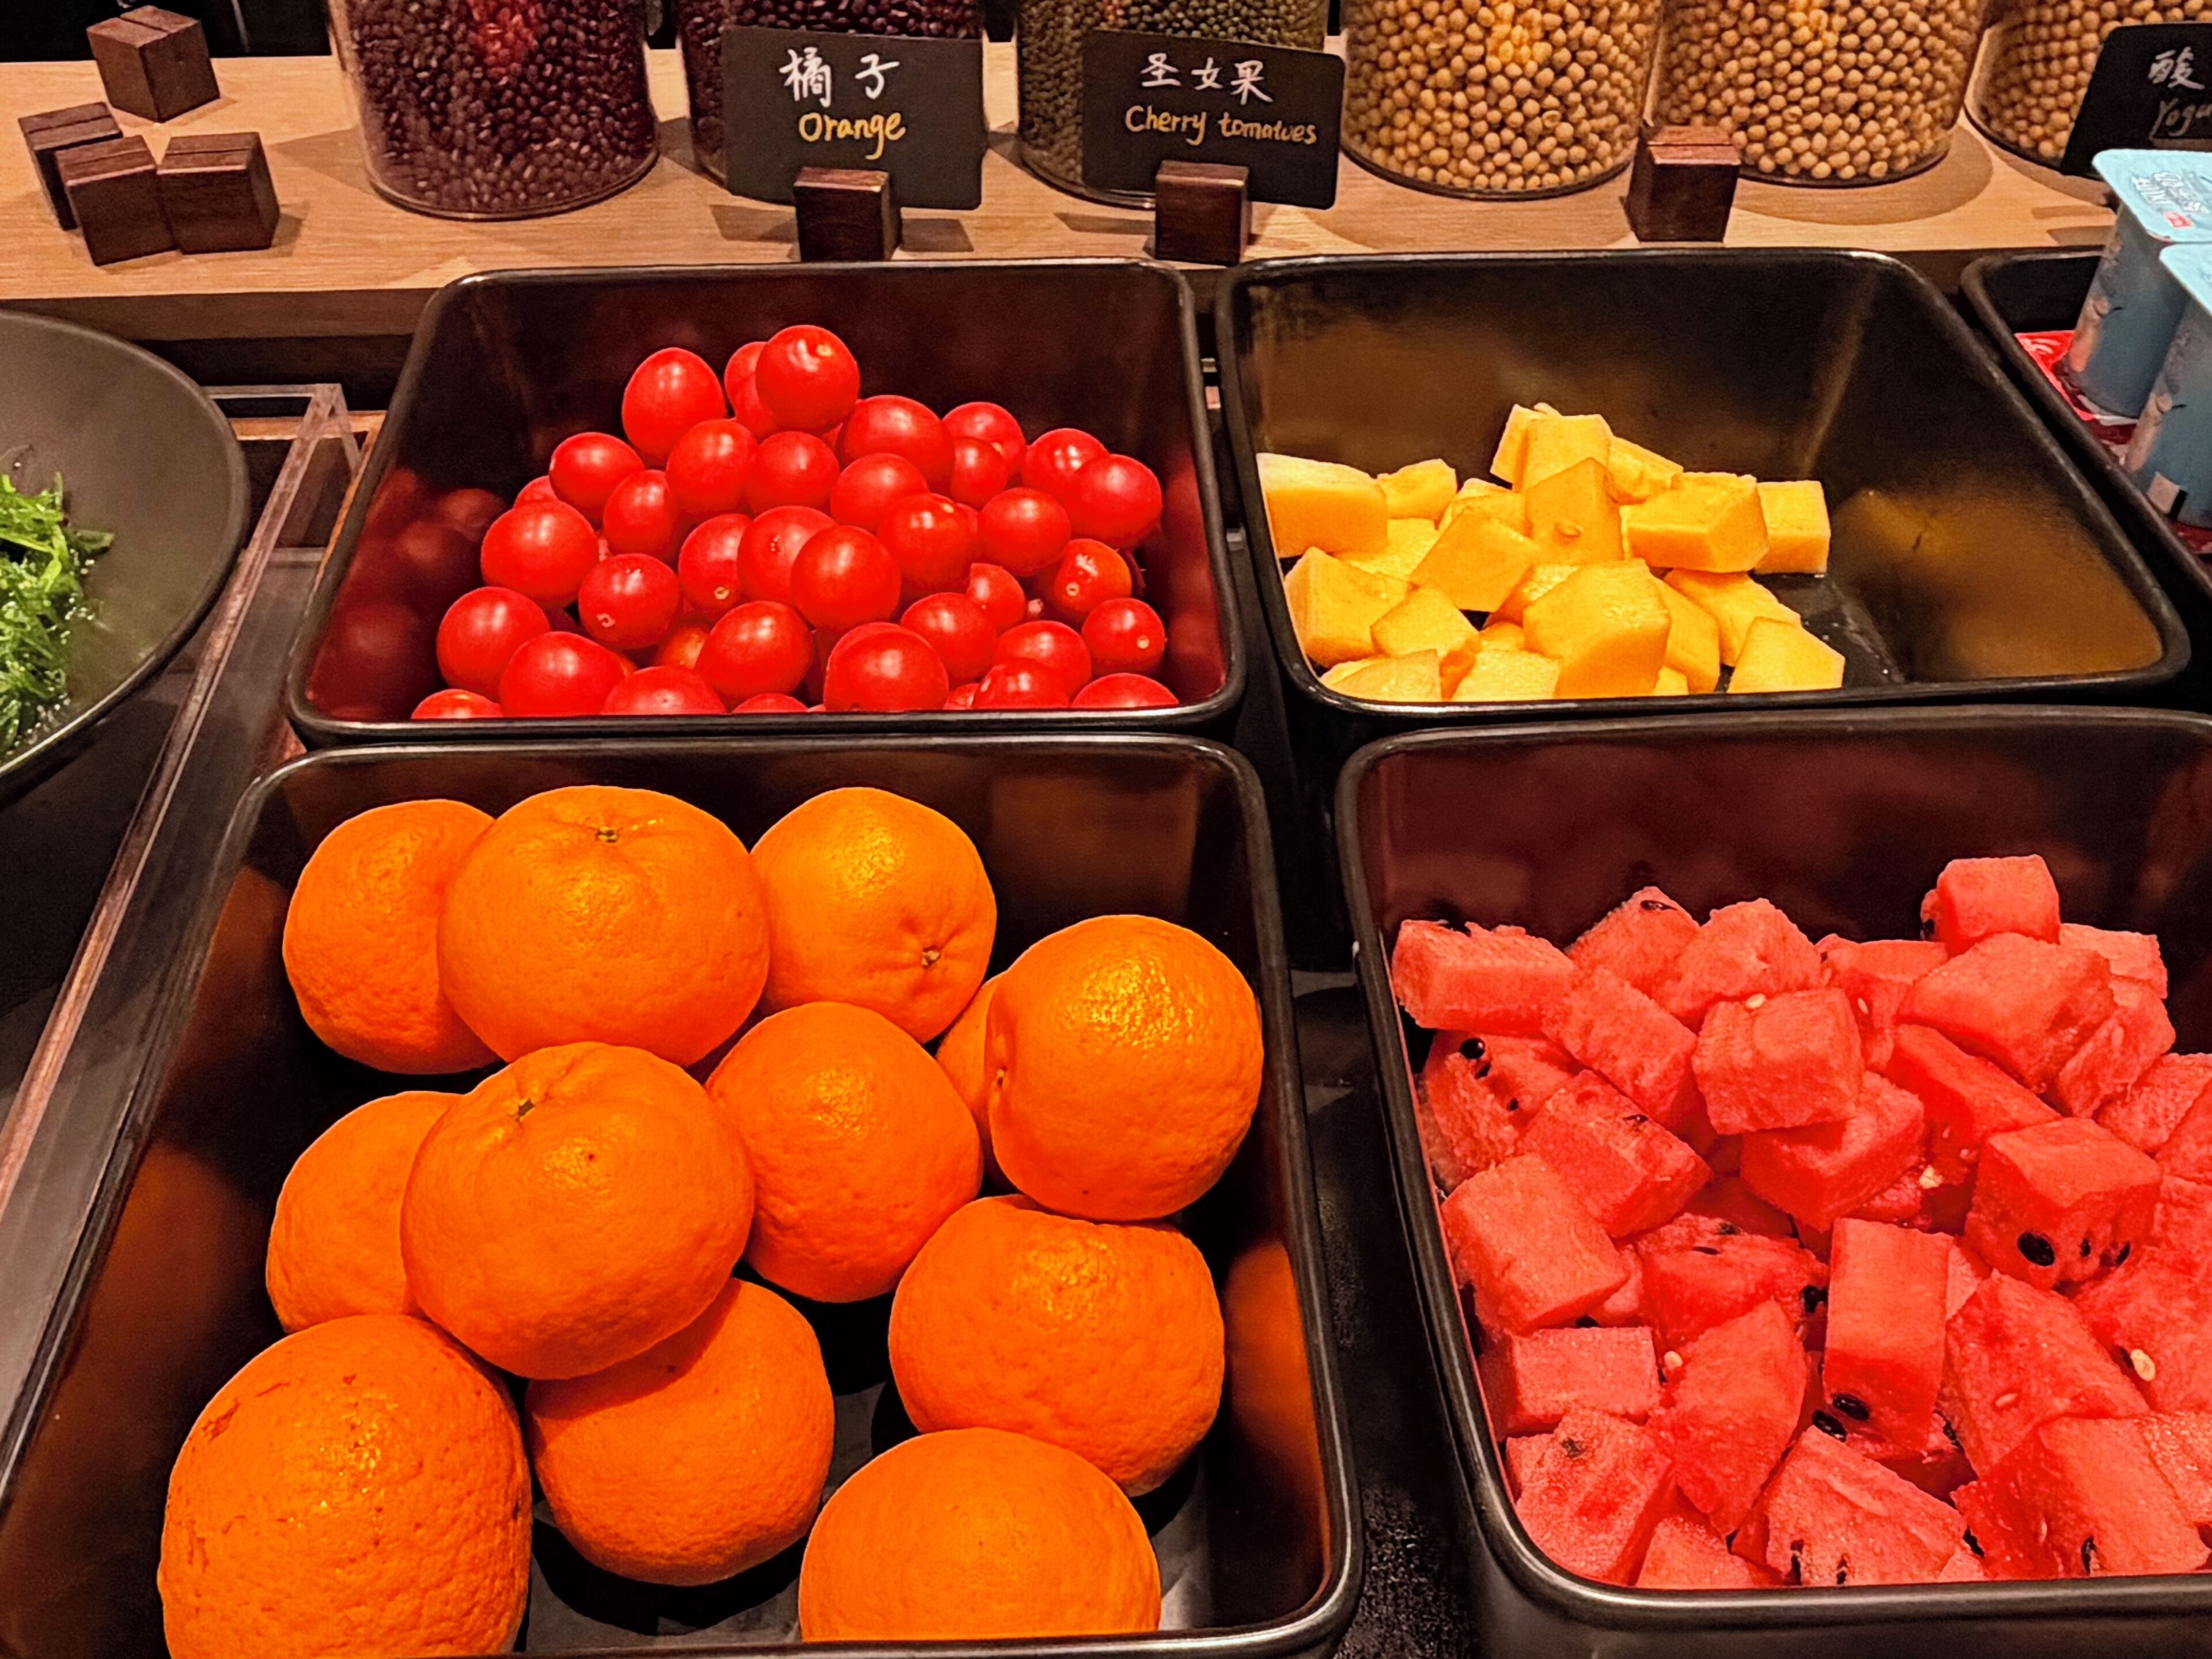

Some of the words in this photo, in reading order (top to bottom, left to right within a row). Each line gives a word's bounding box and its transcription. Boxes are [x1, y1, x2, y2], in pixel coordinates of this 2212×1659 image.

[779, 47, 900, 108] 橘子
[1140, 52, 1273, 105] 圣女果
[2147, 46, 2206, 90] 酸
[798, 112, 906, 160] Orange
[1125, 105, 1207, 146] Cherry
